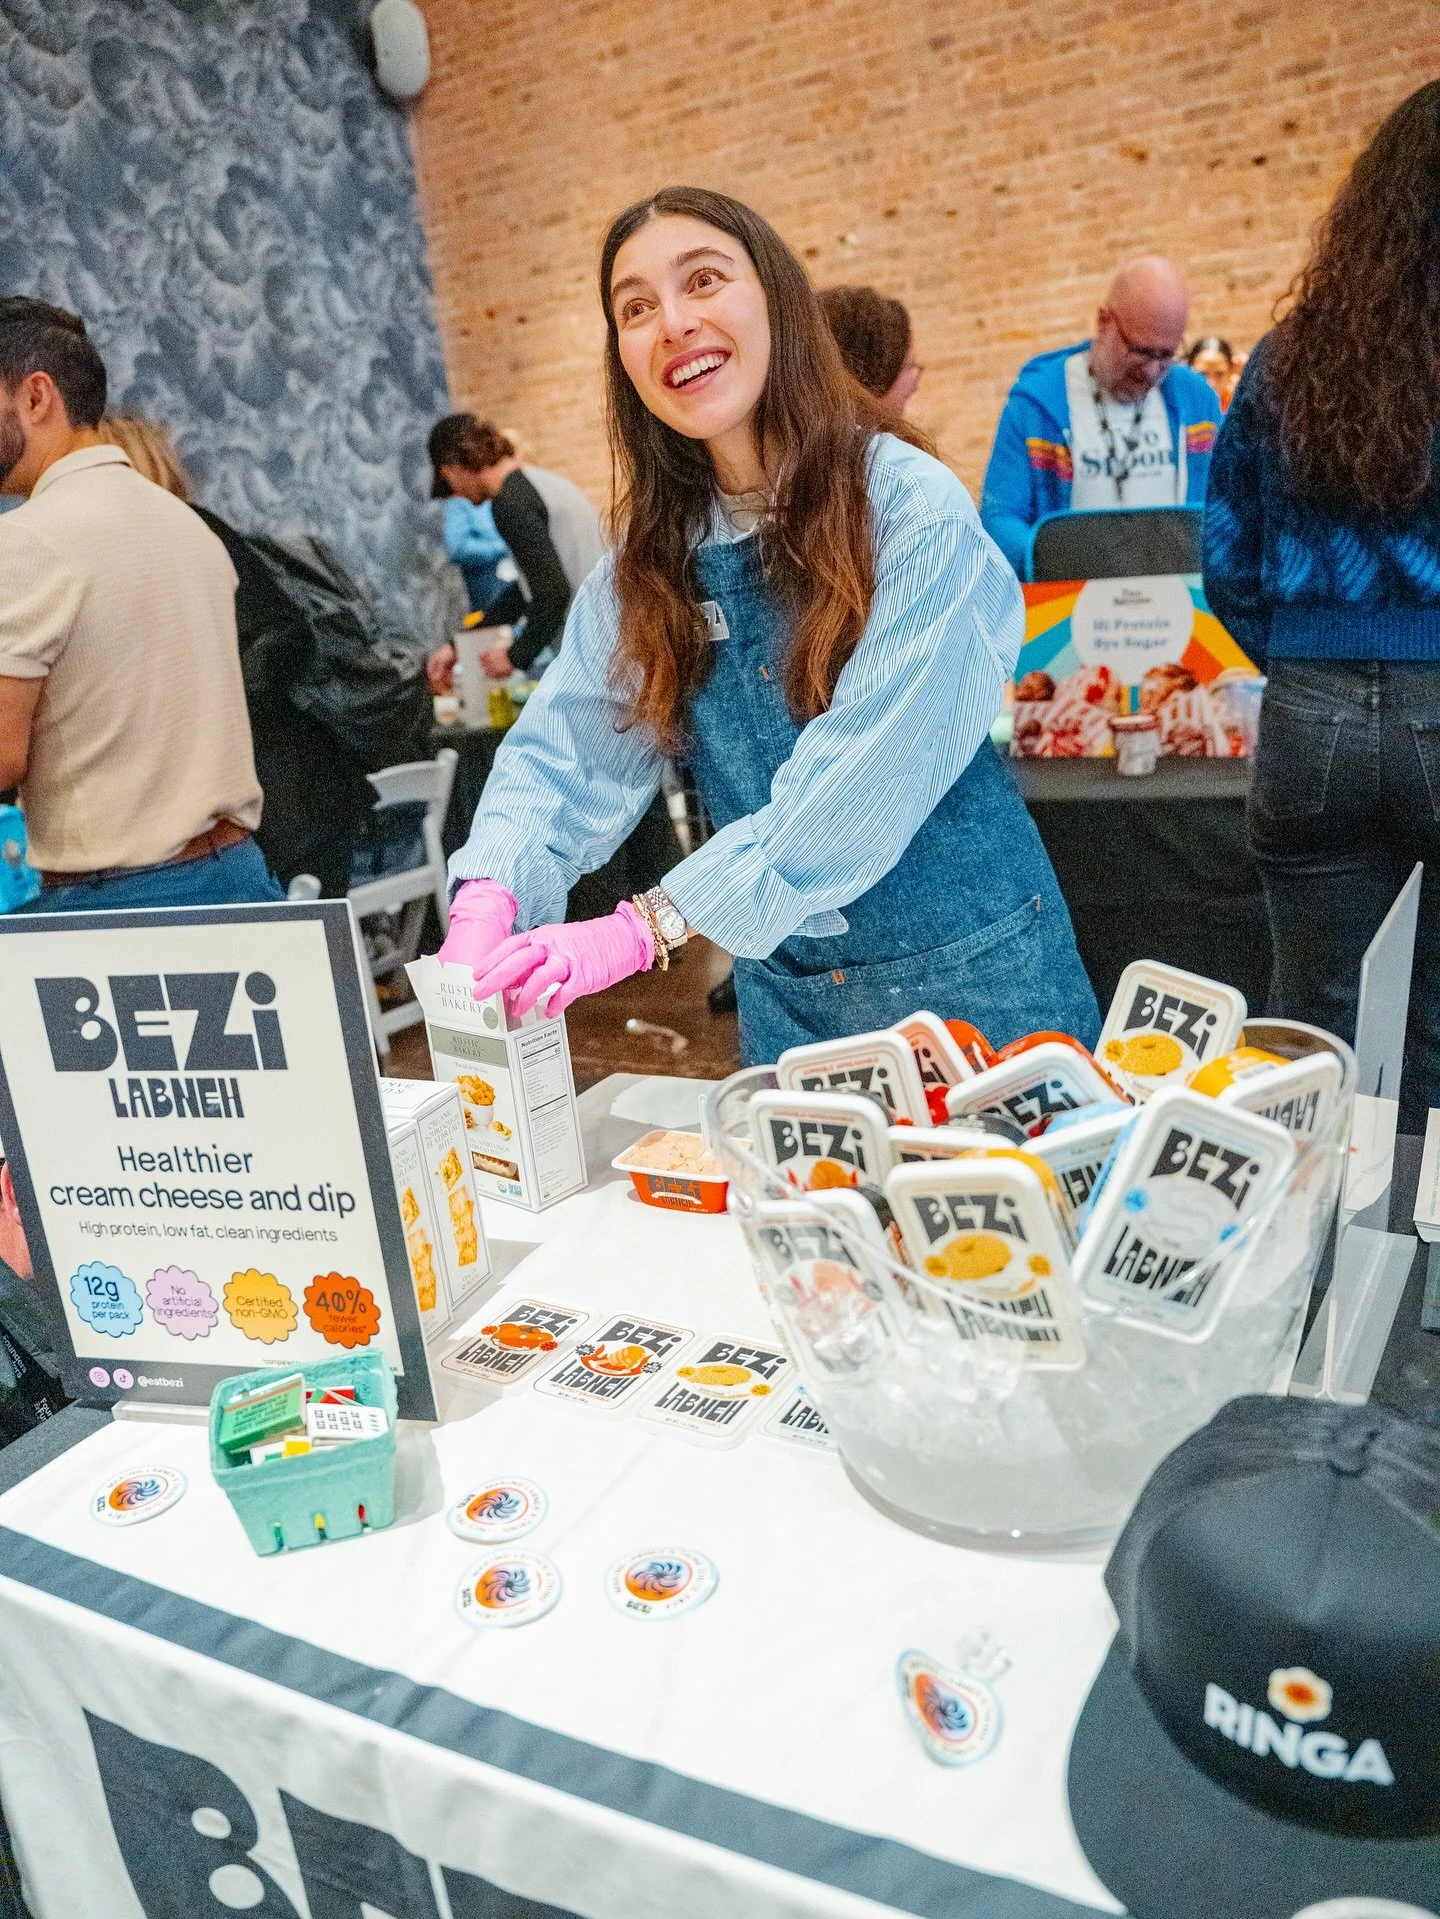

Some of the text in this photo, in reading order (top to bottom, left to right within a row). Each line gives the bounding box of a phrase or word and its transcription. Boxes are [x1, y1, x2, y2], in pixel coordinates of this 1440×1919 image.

[440, 983, 473, 997] RUSTI
[441, 998, 483, 1014] BAKERY
[35, 972, 288, 1072] BEZi
[1123, 985, 1217, 1060] BEZi
[451, 1035, 479, 1049] RUSTIC
[521, 1028, 558, 1048] Nutrition Facts
[453, 1045, 482, 1058] BAKERY
[108, 1078, 245, 1118] LABNEH
[982, 1080, 1081, 1126] EZi
[117, 1145, 253, 1173] Healthier
[770, 1120, 867, 1173] BEZi
[1150, 1128, 1259, 1211] BEZi
[50, 1183, 356, 1218] cream cheese and dip
[912, 1194, 1027, 1244] BEZi
[80, 1221, 338, 1244] High protein, low fat, clean ingredients
[84, 1276, 119, 1301] 12g
[163, 1296, 201, 1306] artificial
[171, 1285, 186, 1296] No
[92, 1301, 124, 1310] protein
[157, 1306, 214, 1319] ingredients
[235, 1308, 288, 1319] non-GMO
[236, 1295, 283, 1308] Certified
[316, 1289, 367, 1314] 40%
[92, 1310, 130, 1320] per pack
[329, 1313, 357, 1323] fewer
[500, 1304, 578, 1338] BEZi
[596, 1320, 682, 1358] BEZi
[456, 1338, 537, 1374] LABNEH
[697, 1342, 787, 1380] BEZi
[137, 1375, 184, 1387] @eatbezi
[550, 1359, 639, 1399] LABNEH
[654, 1382, 749, 1425] LABNEH
[1204, 1683, 1395, 1786] RINGA
